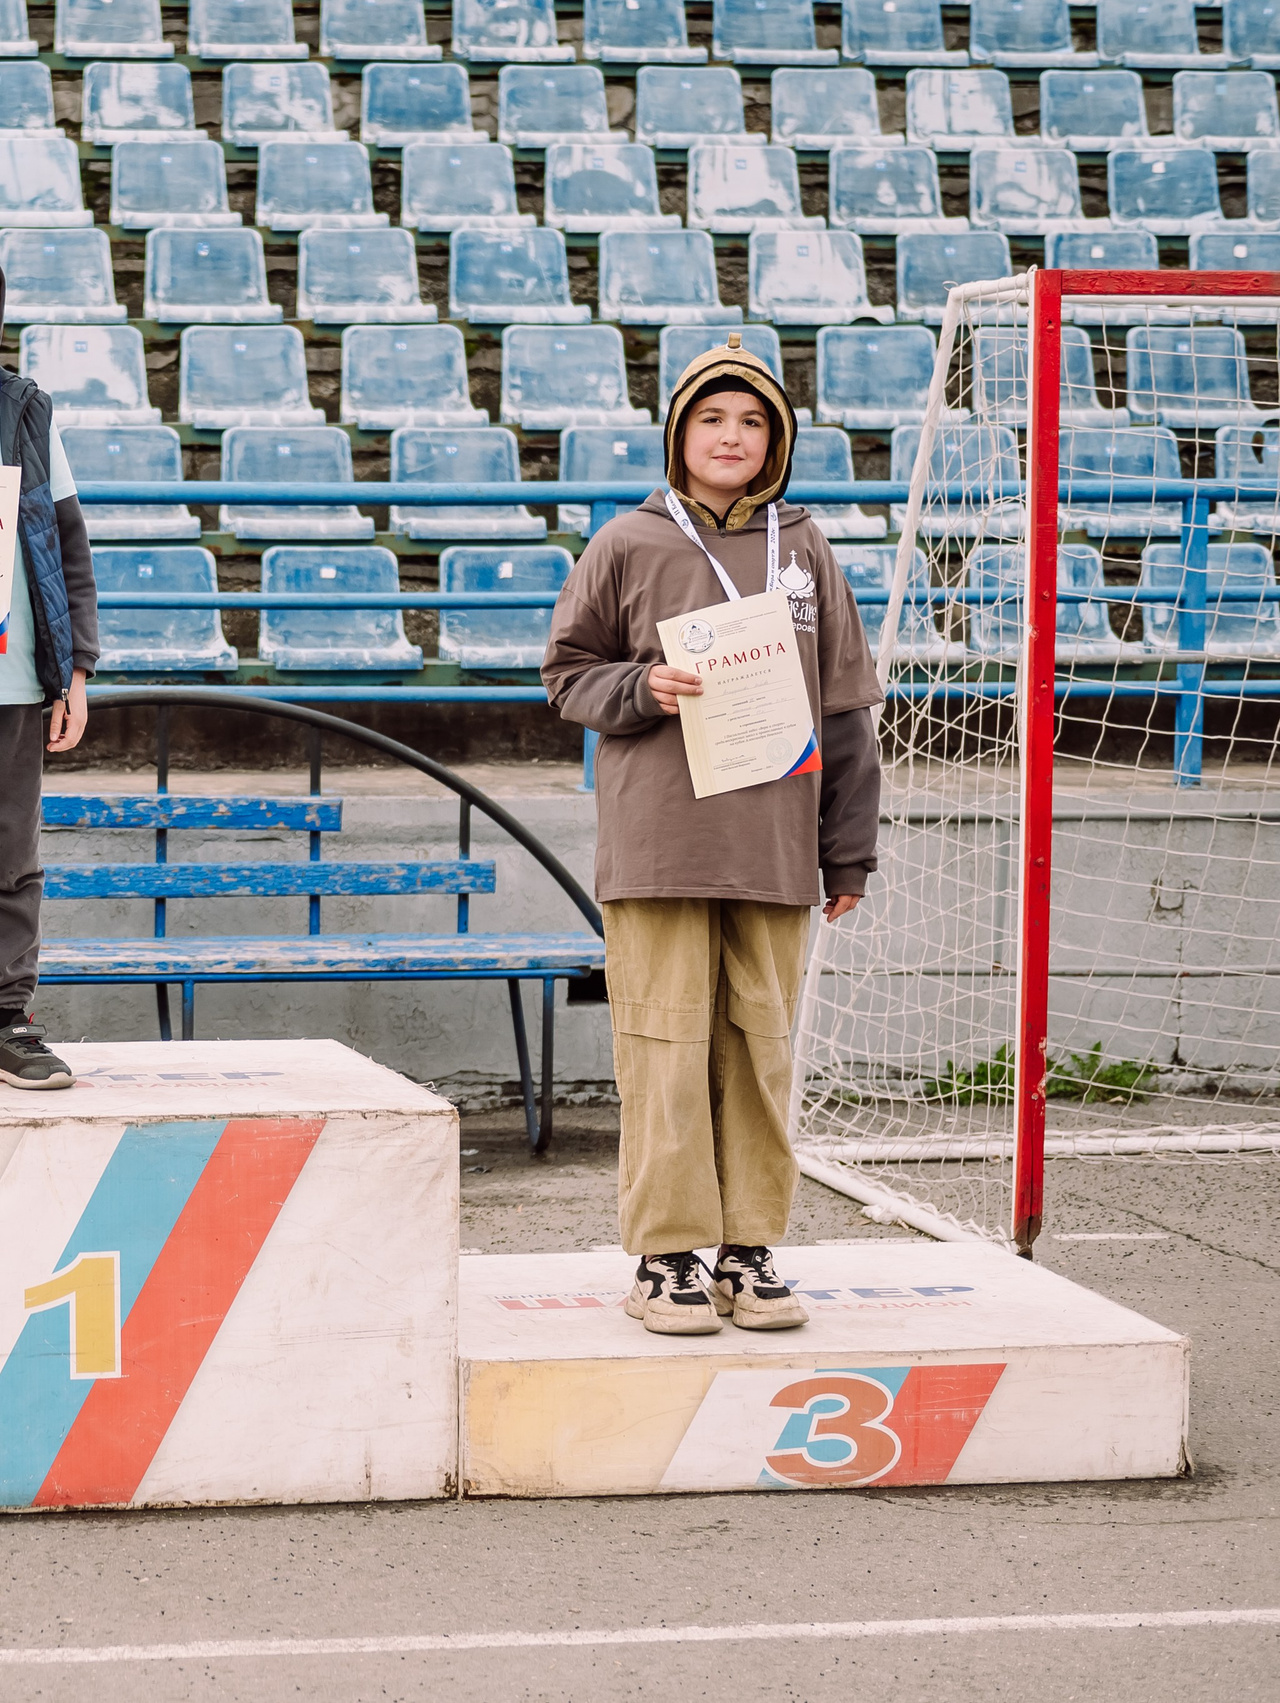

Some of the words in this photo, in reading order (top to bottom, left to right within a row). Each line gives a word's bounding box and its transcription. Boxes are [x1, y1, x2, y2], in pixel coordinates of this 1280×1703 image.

[695, 642, 786, 674] ГРАМОТА
[717, 668, 772, 685] НАГРАЖДАЕТСЯ
[23, 1250, 122, 1381] 1
[765, 1371, 902, 1486] 3
